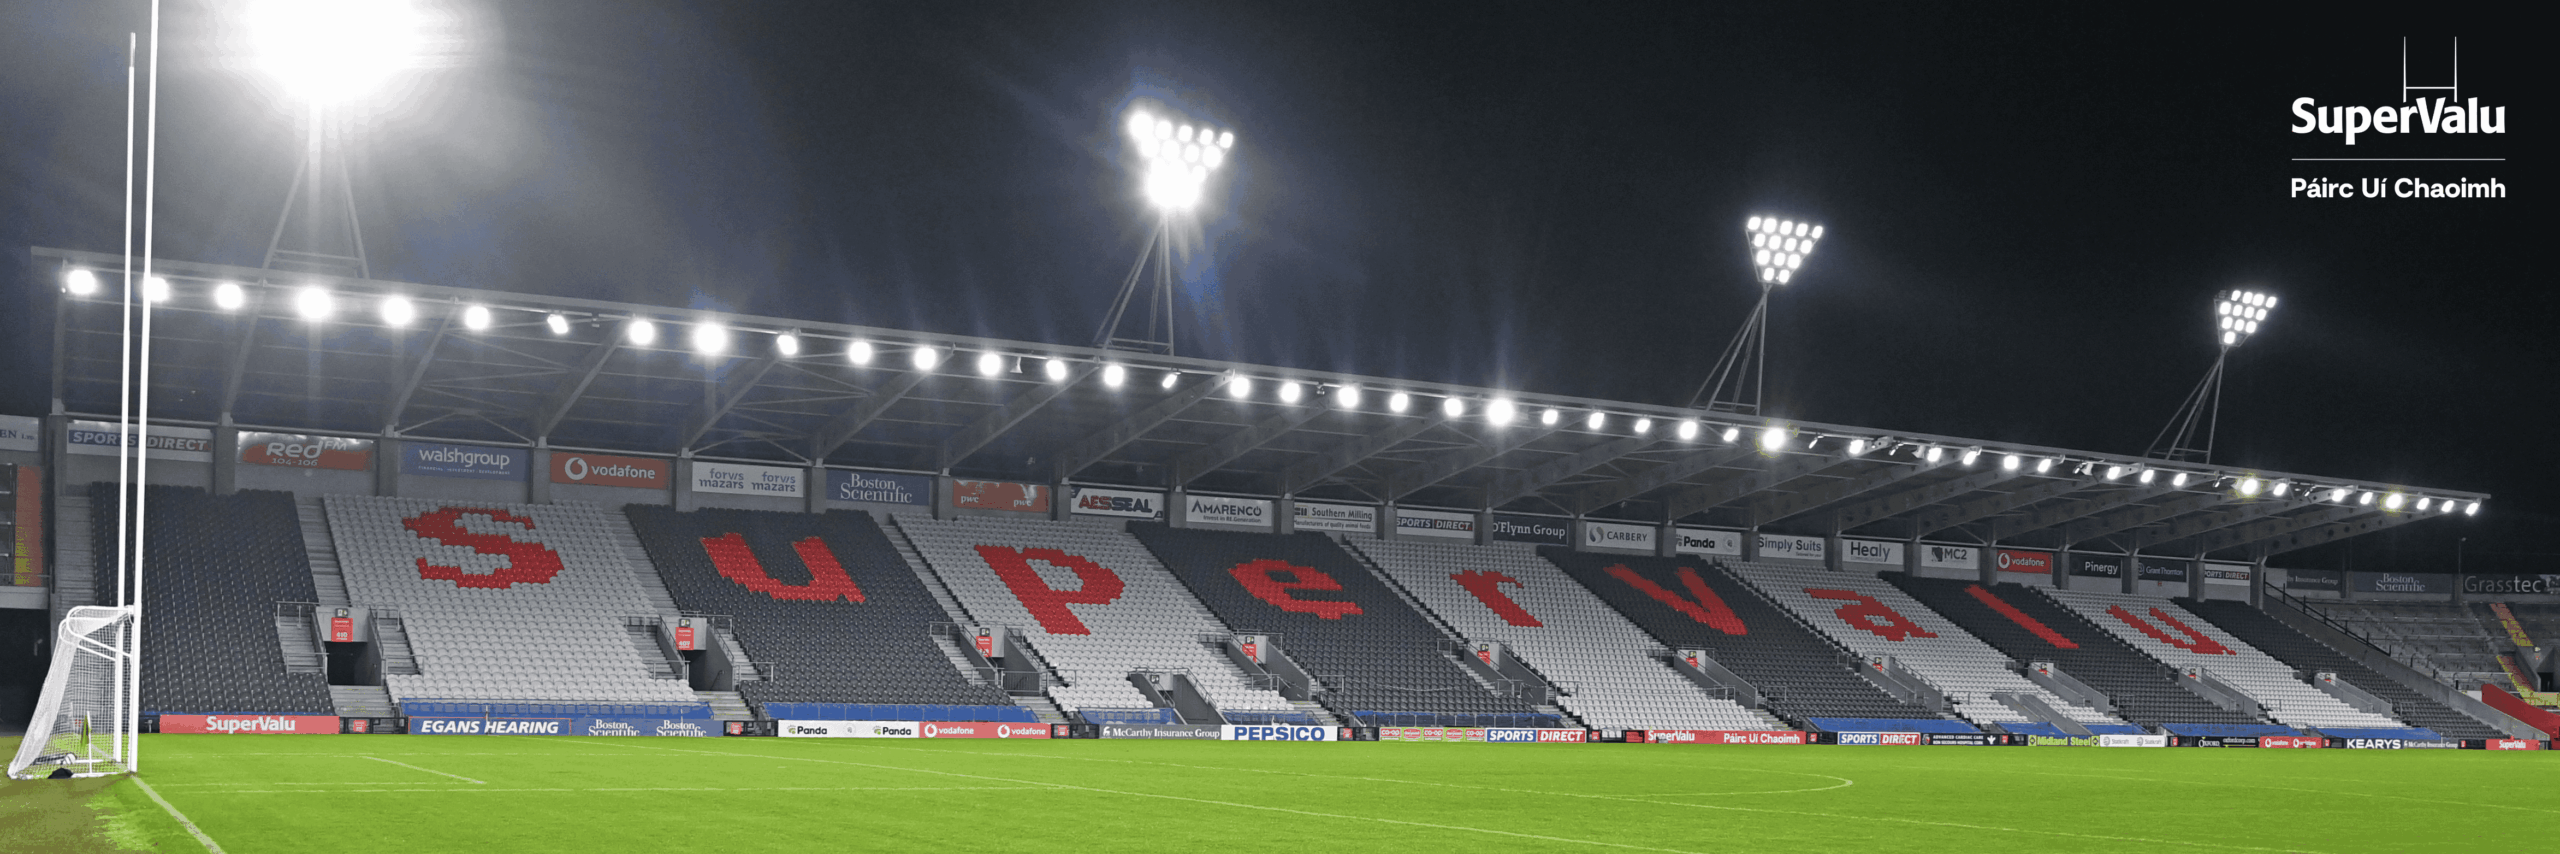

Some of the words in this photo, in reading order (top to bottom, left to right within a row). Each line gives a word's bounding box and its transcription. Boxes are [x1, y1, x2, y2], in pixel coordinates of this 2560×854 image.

[146, 436, 208, 451] DIRECT
[266, 440, 322, 459] Red
[324, 441, 347, 450] FM
[272, 457, 318, 466] 104-106
[419, 447, 511, 470] walshgroup
[591, 464, 656, 480] vodafone
[709, 468, 744, 481] forvis
[762, 471, 796, 484] forvis
[699, 479, 744, 490] mazars
[752, 482, 796, 492] mazars
[850, 473, 896, 490] Boston
[840, 483, 912, 504] Scientific
[960, 495, 980, 504] pwc
[1191, 499, 1262, 517] AMARENCO
[1312, 508, 1346, 518] Southern
[1348, 510, 1372, 520] Milling
[1436, 520, 1470, 530] DIRECT
[1533, 524, 1566, 540] Group
[1607, 531, 1648, 542] CARBERY
[1684, 536, 1715, 548] Panda
[1758, 537, 1792, 552] Simply
[1796, 540, 1822, 552] Suits
[1850, 541, 1890, 562] Healy
[1944, 548, 1967, 560] MC2
[2012, 557, 2044, 566] vodafone
[2085, 561, 2118, 574] Pinergy
[2146, 566, 2160, 574] Grant
[2161, 567, 2183, 576] Thornton
[2225, 572, 2248, 580] DIRECT
[2383, 572, 2414, 584] Boston
[2464, 575, 2542, 592] Grasstec
[2376, 580, 2426, 592] Scientific
[206, 716, 296, 734] SuperValu
[421, 720, 480, 733] EGANS
[484, 720, 559, 734] HEARING
[596, 719, 628, 730] Boston
[663, 720, 695, 730] Boston
[797, 726, 828, 734] Panda
[882, 726, 912, 735] Panda
[938, 726, 974, 734] vodafone
[588, 726, 640, 736] Scientific
[656, 726, 706, 737] Scientific
[1011, 727, 1046, 735] vodafone
[1112, 728, 1152, 738] McCarthy
[1154, 728, 1194, 737] Insurance
[1194, 728, 1220, 738] Group
[1234, 726, 1325, 741] PEPSICO
[1490, 730, 1534, 741] SPORTS
[1540, 730, 1583, 742] DIRECT
[1724, 732, 1746, 744] Páirc
[1760, 733, 1800, 744] Chaoimh
[1841, 734, 1878, 744] SPORTS
[1882, 734, 1918, 745] DIRECT
[2037, 736, 2068, 746] Midland
[2070, 736, 2091, 746] Steel
[2347, 738, 2401, 749] KEARYS
